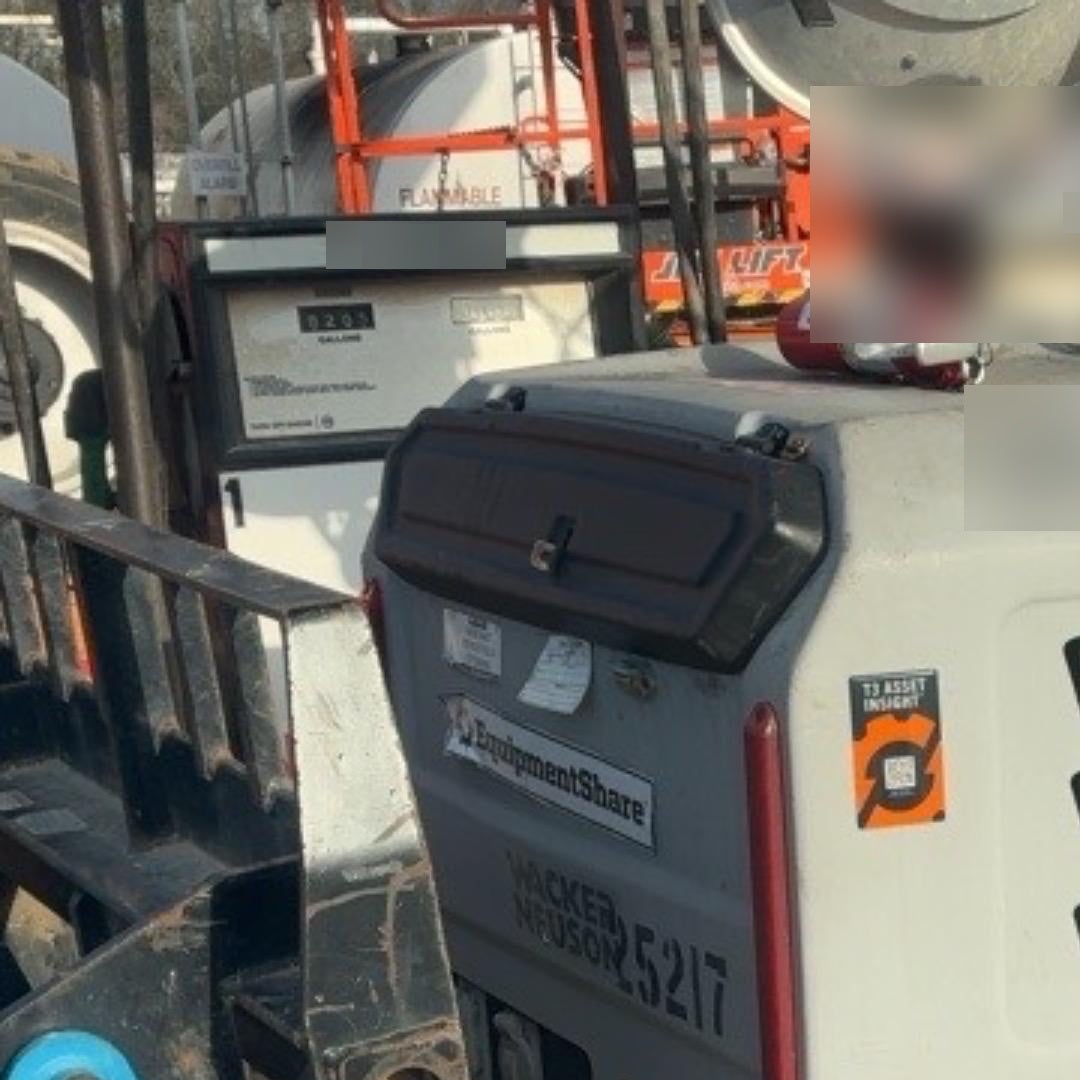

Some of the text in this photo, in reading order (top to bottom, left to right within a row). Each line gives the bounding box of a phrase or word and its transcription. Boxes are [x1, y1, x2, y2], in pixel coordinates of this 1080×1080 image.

[730, 246, 806, 275] LIFT
[224, 477, 245, 528] 1
[862, 694, 920, 712] INSIGHT
[883, 678, 926, 695] ASSET
[474, 718, 646, 826] EquipmentShare
[506, 850, 618, 936] WACKER
